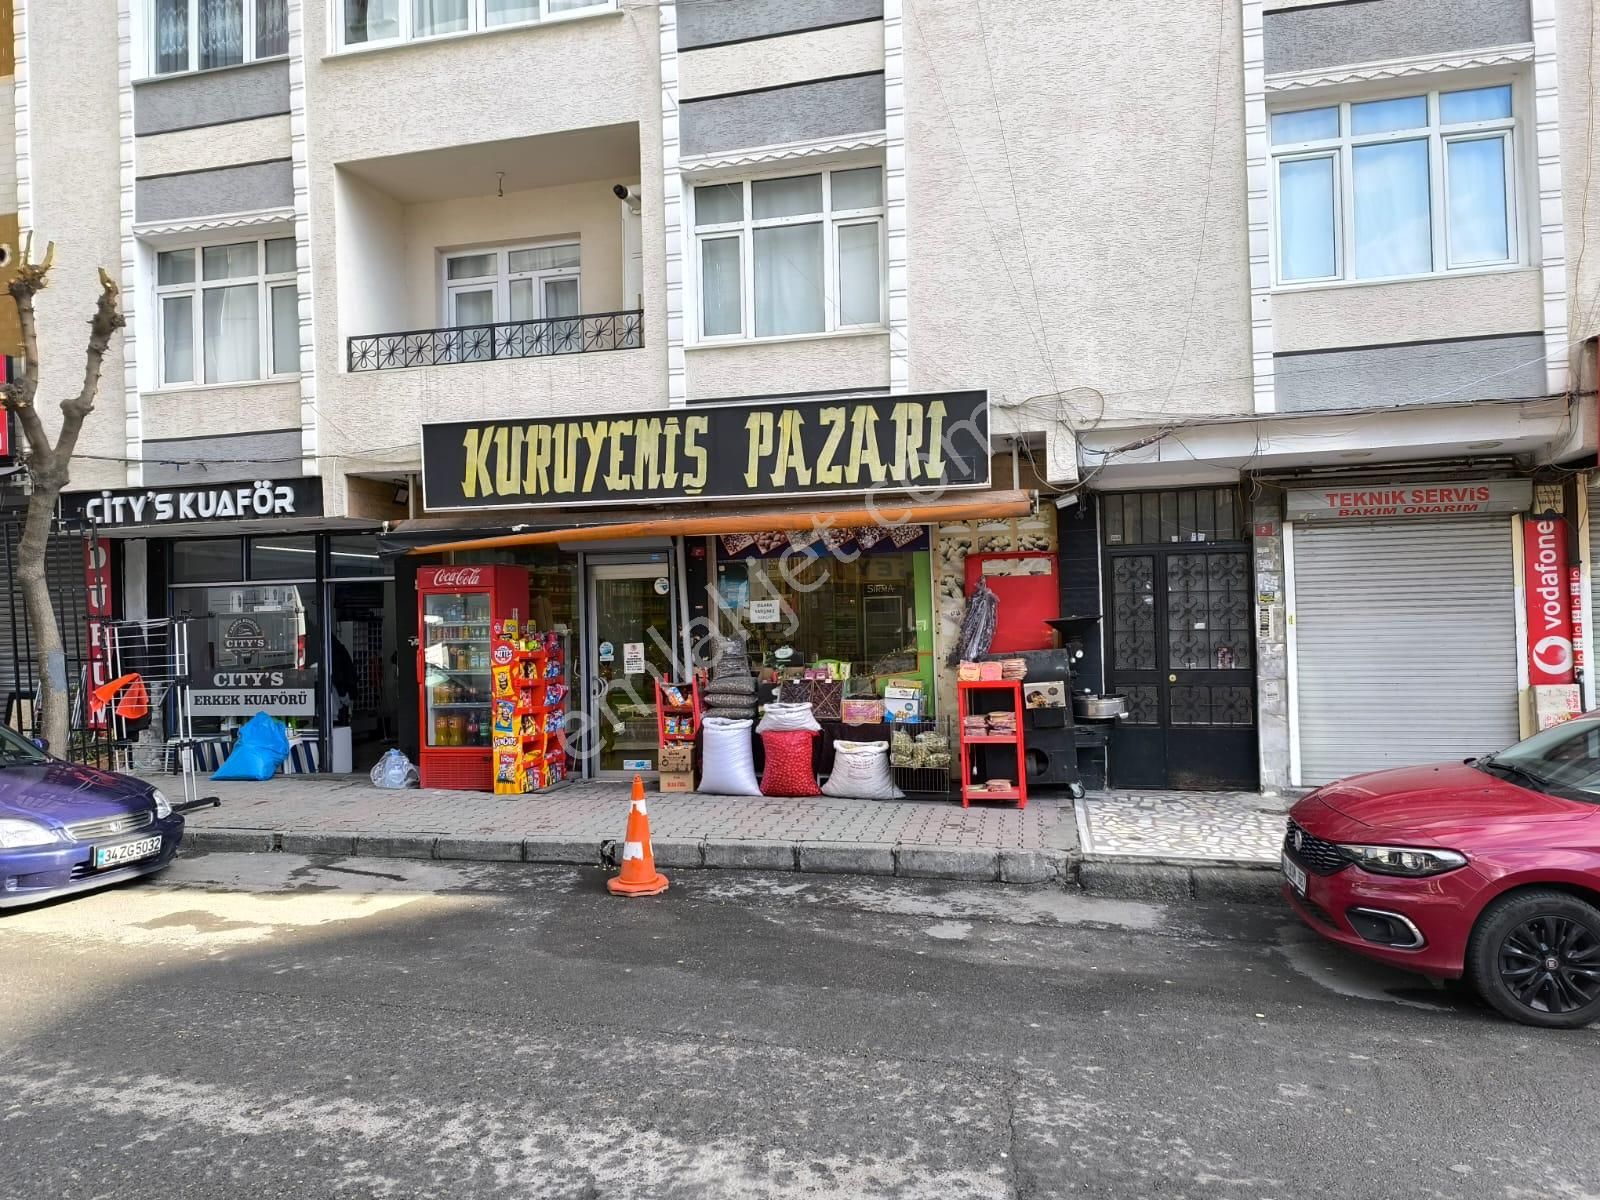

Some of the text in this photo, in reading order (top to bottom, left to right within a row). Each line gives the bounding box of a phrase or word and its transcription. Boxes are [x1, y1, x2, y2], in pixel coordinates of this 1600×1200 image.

[461, 399, 948, 499] KURUYEMİŞ PAZARI
[86, 480, 296, 525] CİTY'S KUAFÖR
[1337, 503, 1479, 518] BAKIM ONARIM
[433, 567, 481, 586] Coca-Cola
[1534, 519, 1562, 630] vodafone
[226, 639, 265, 648] CITY'S
[213, 671, 284, 687] CITY'S
[193, 690, 308, 706] ERKEK KUAFÖRÜ
